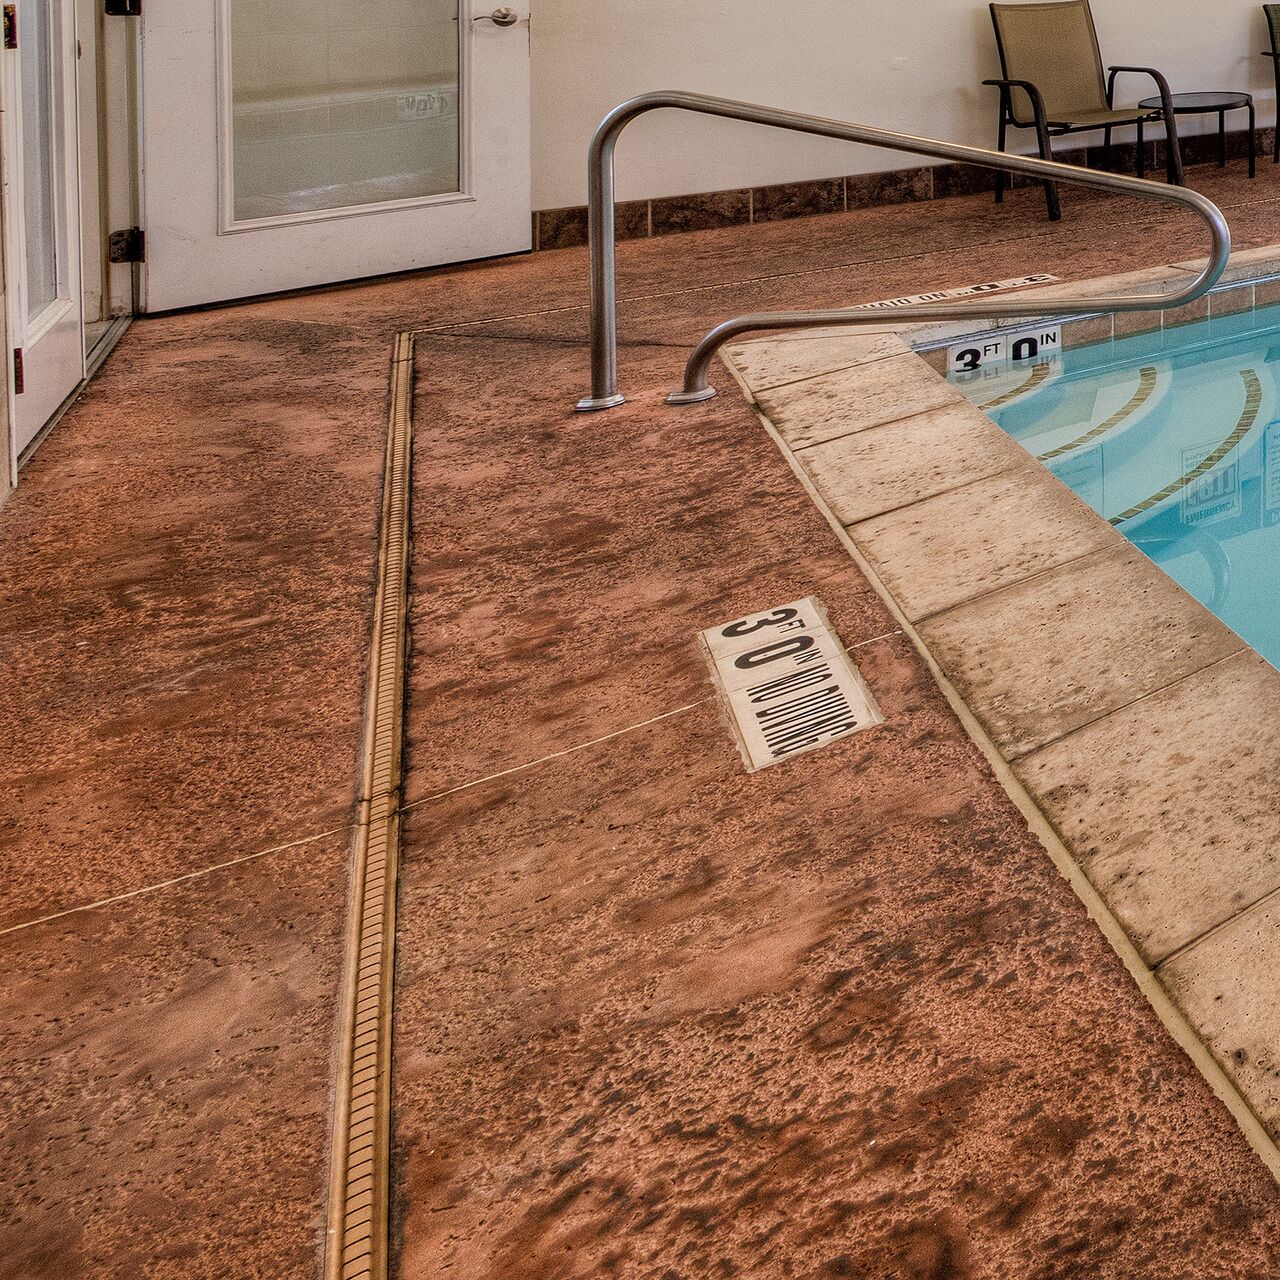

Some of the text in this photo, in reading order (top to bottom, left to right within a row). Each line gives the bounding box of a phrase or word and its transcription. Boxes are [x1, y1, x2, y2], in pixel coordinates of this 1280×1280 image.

[918, 292, 948, 302] NO
[955, 349, 981, 373] 3
[984, 343, 1001, 356] FT
[1012, 337, 1038, 360] 0
[1040, 332, 1056, 345] IN
[722, 608, 857, 758] 3 FT 0 IN NO DIVING
